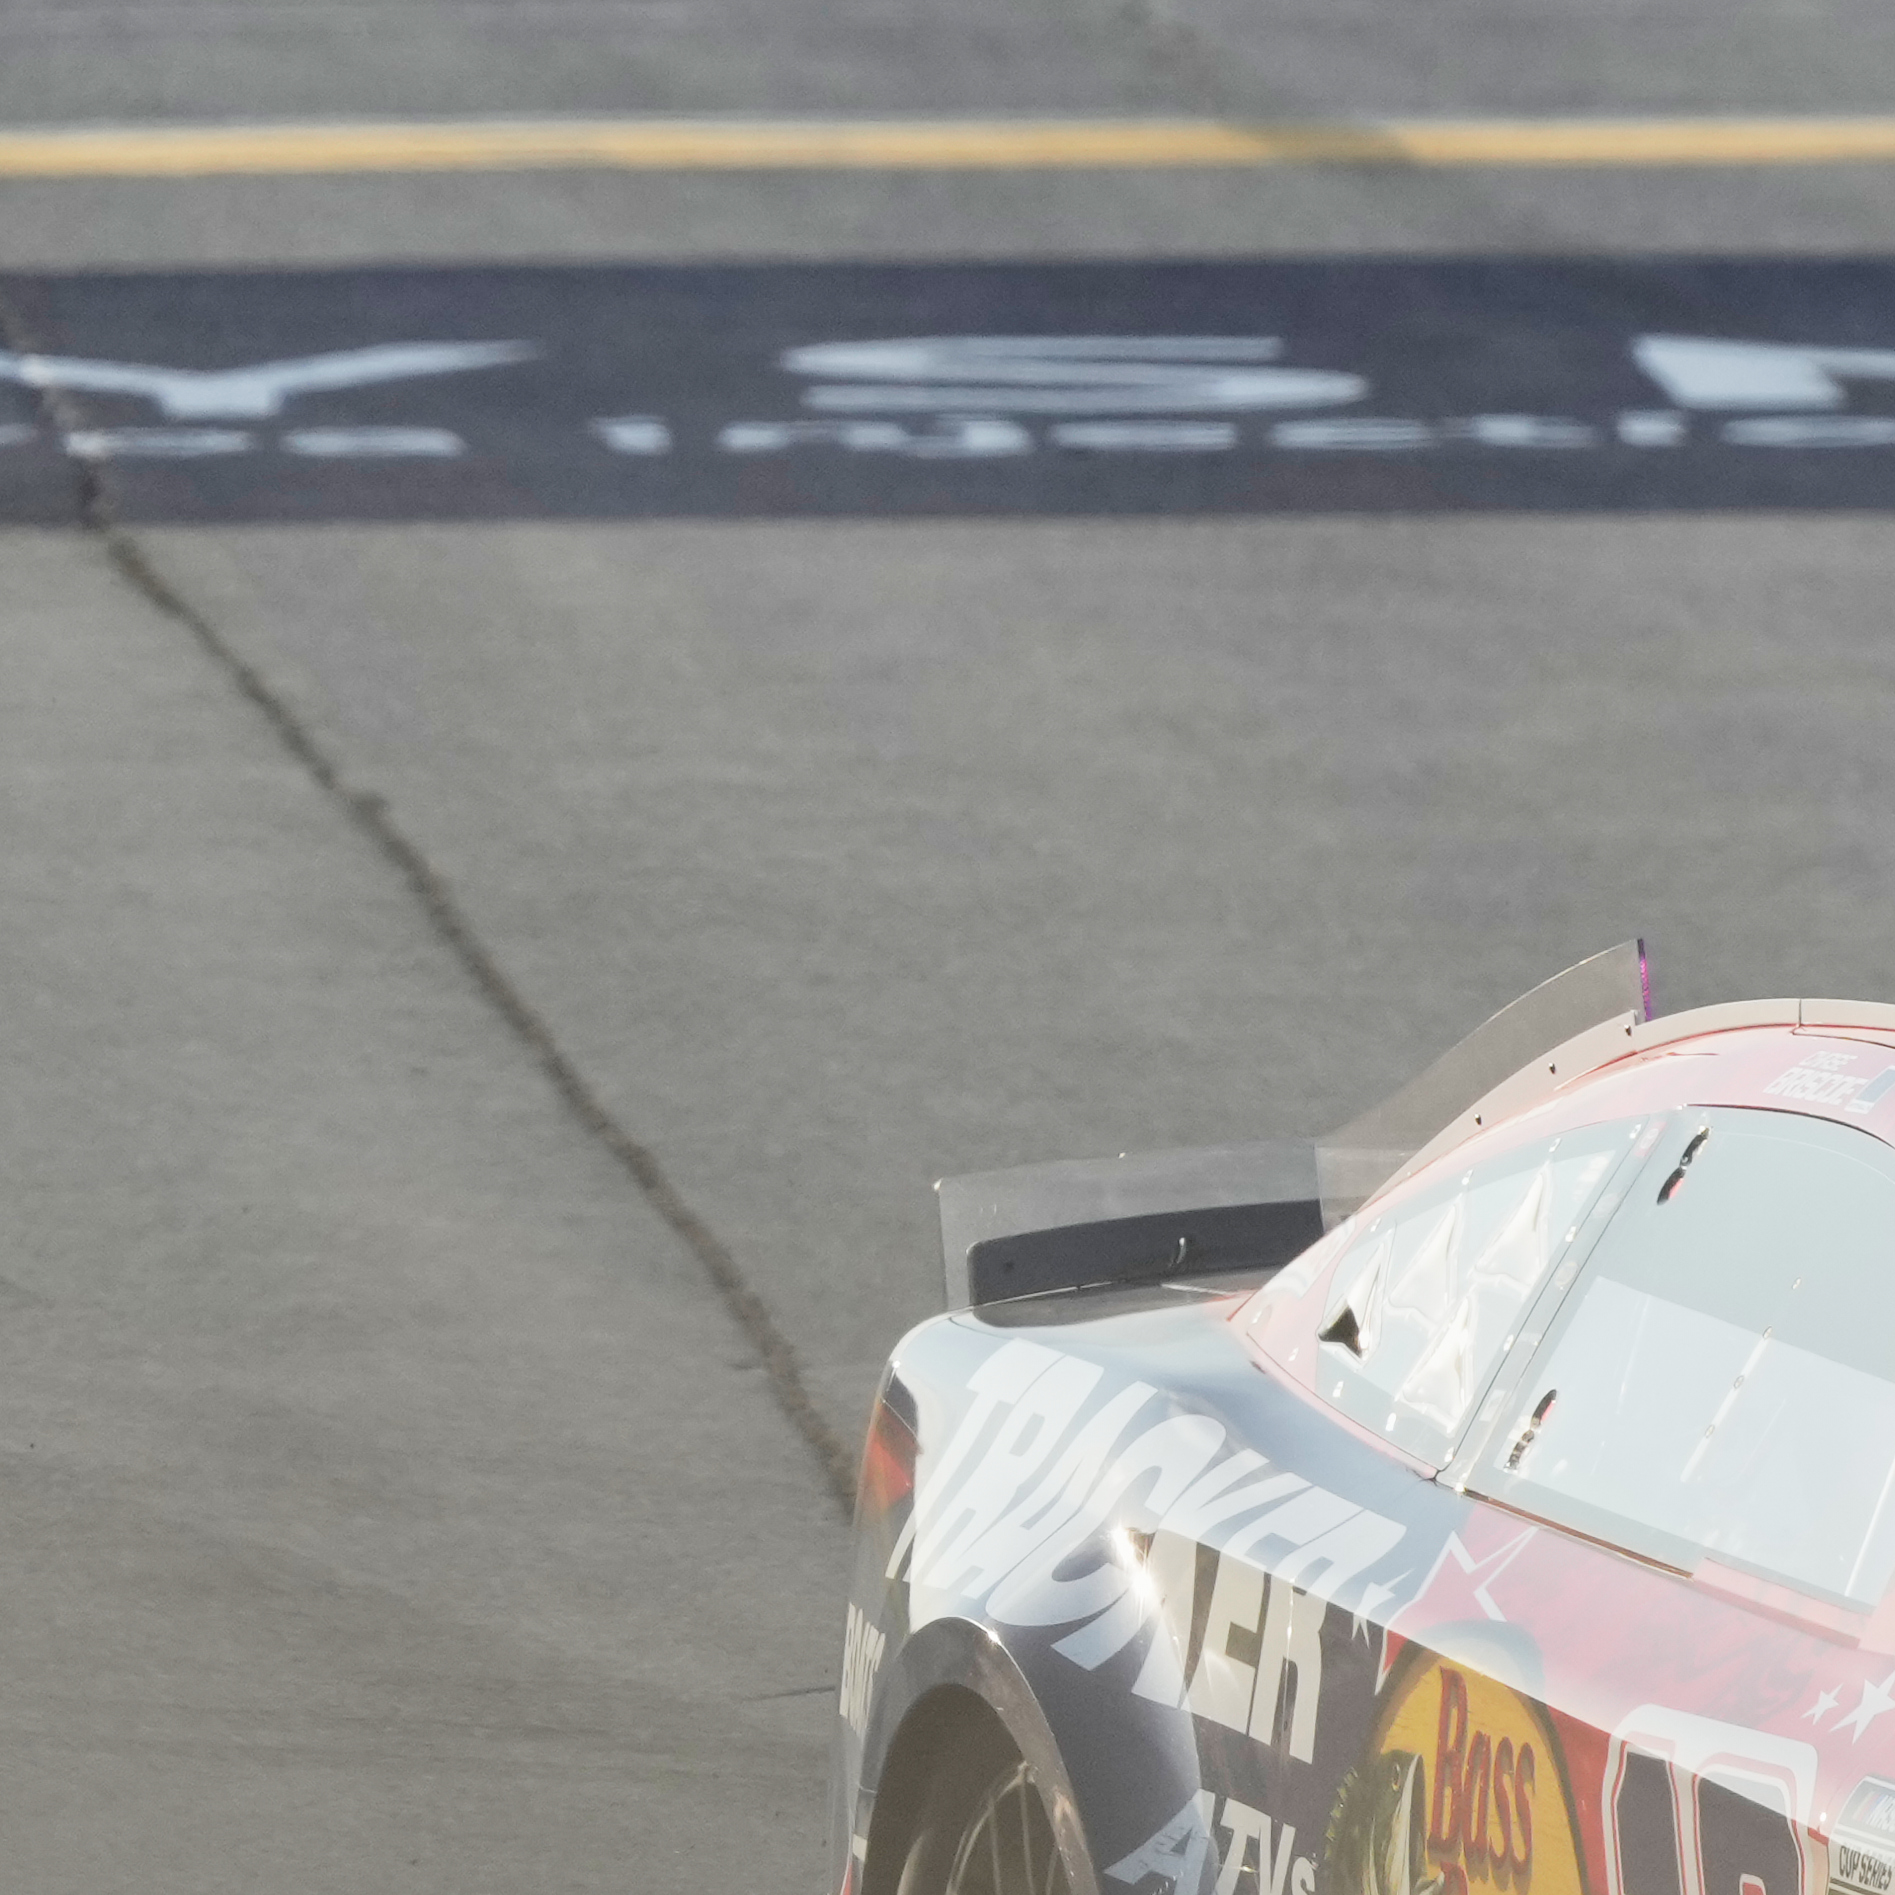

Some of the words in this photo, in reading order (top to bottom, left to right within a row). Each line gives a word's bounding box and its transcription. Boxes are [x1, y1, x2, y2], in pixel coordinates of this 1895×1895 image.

[884, 1337, 1406, 1764] TRACKER
[1426, 1666, 1536, 1890] Bass
[1839, 1844, 1861, 1881] CUP
